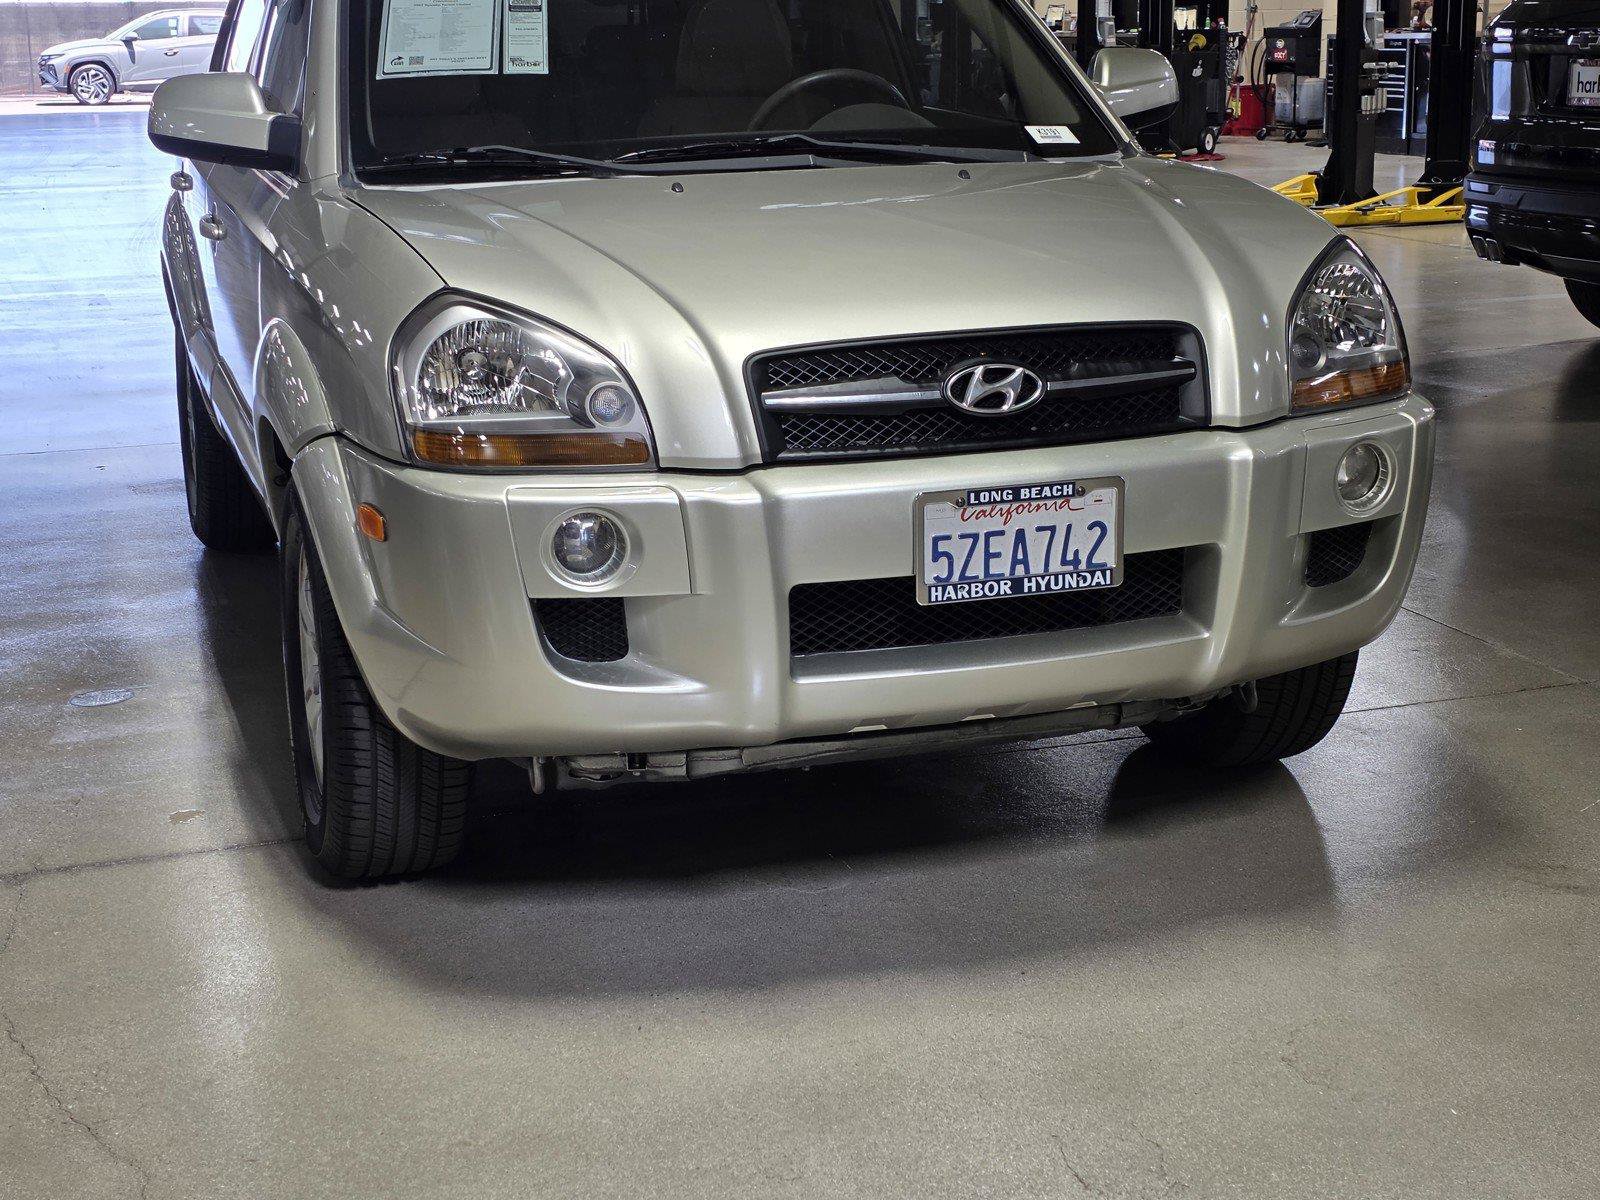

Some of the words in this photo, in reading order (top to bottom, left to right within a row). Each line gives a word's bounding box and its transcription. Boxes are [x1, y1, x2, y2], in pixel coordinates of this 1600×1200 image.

[969, 489, 1014, 505] LONG
[1020, 484, 1074, 500] BEACH
[960, 498, 1084, 526] California
[930, 520, 1109, 583] 5ZEA742
[930, 580, 1013, 602] HARBOR
[1023, 569, 1112, 593] HYUNDAI
